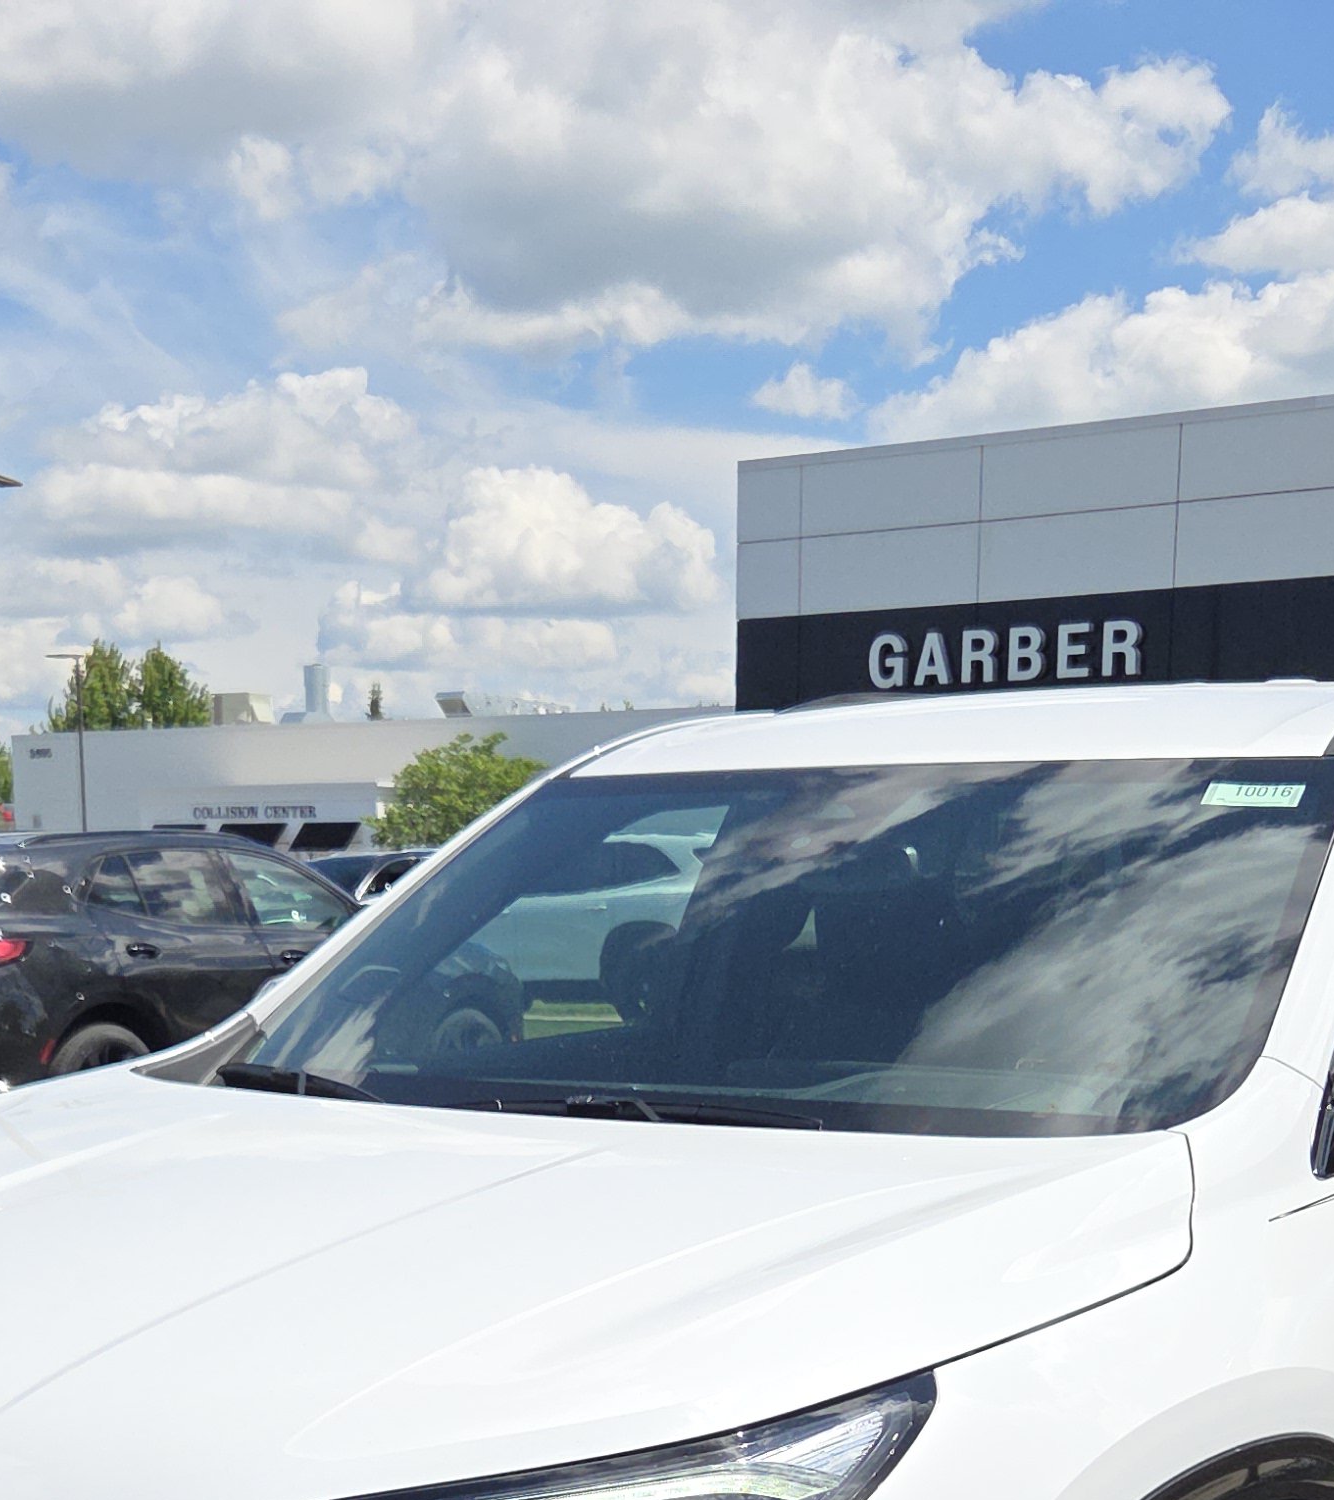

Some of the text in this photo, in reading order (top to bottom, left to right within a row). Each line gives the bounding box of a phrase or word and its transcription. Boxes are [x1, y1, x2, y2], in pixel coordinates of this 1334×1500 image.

[868, 619, 1143, 690] GARBER
[1235, 786, 1293, 798] 10016
[193, 805, 317, 820] COLLISION CENTER
